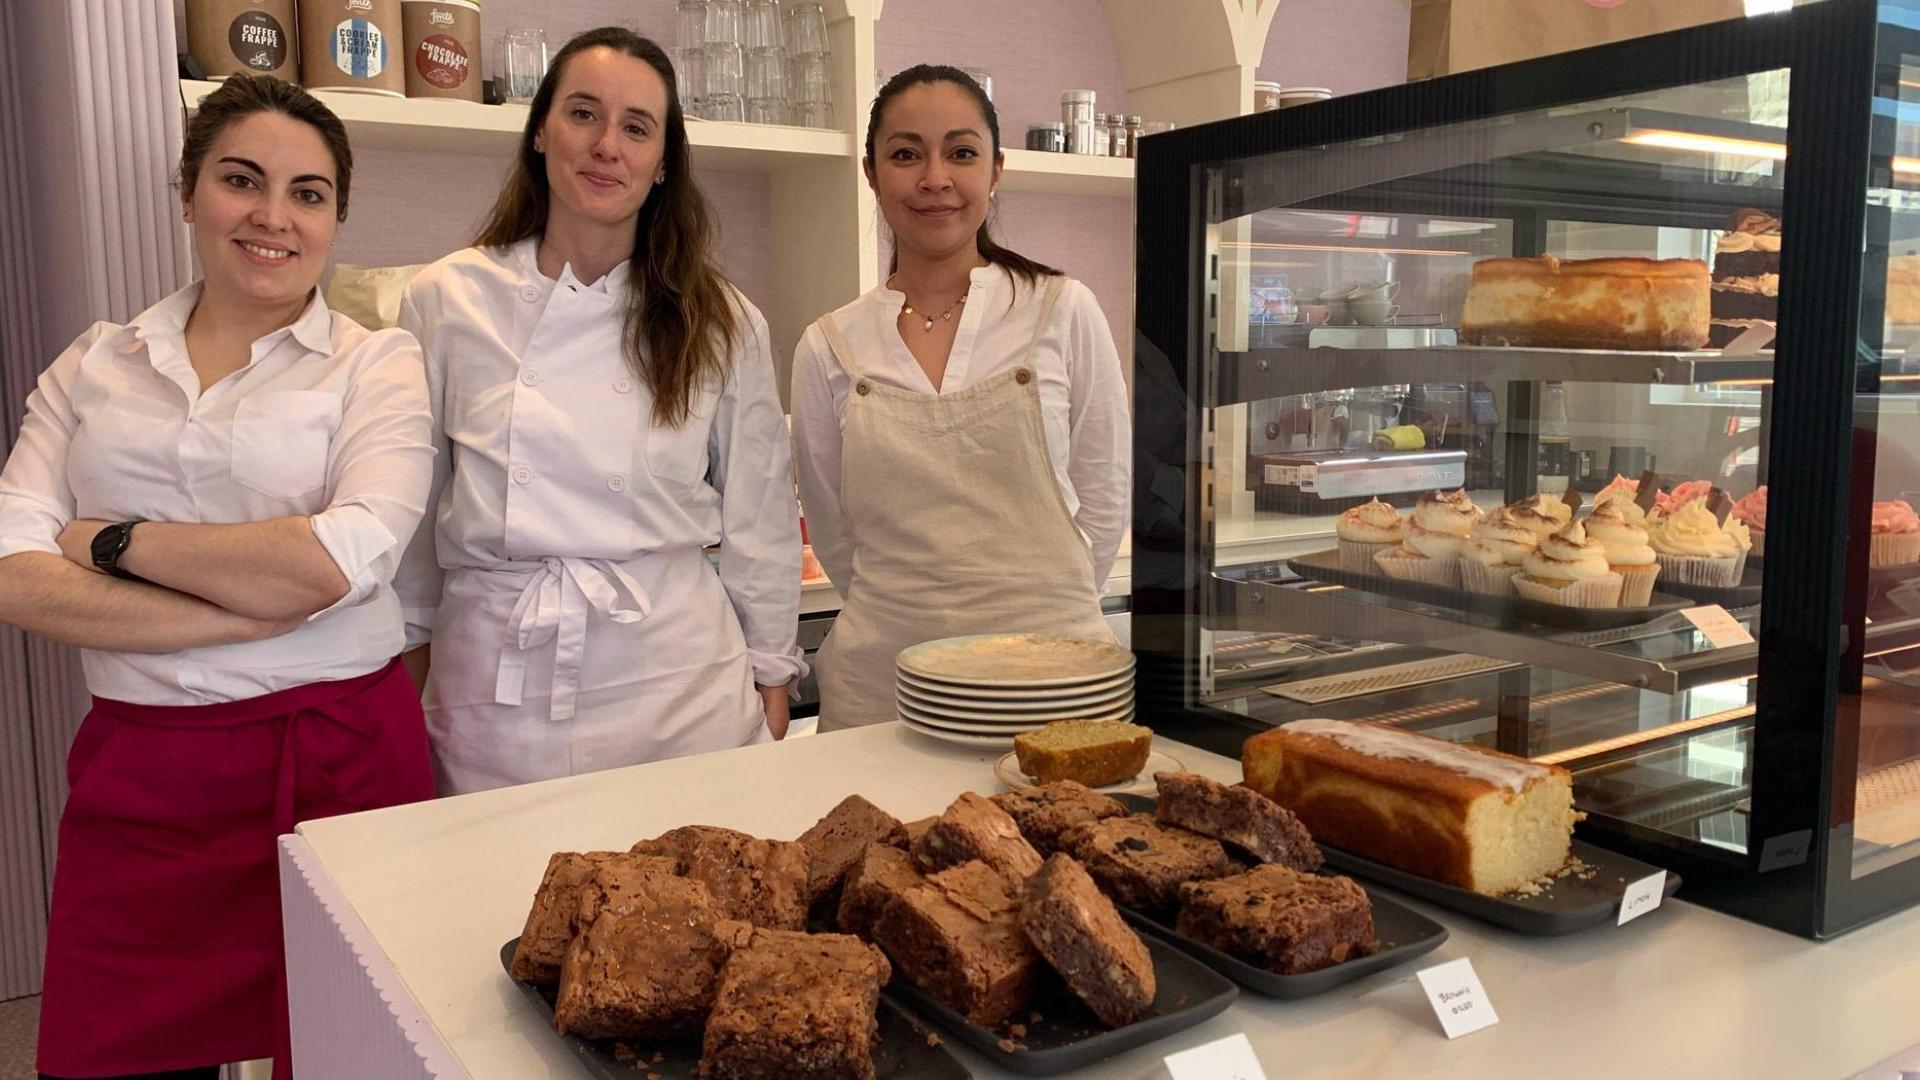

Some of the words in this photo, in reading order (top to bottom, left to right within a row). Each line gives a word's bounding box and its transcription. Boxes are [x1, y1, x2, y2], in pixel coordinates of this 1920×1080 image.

[243, 24, 277, 39] COFFEE
[340, 28, 378, 42] COOKIES
[242, 33, 278, 48] FRAPPE
[342, 46, 376, 58] FRAPPE
[421, 41, 468, 66] CHOCOLATE
[427, 50, 460, 70] FRAPPE
